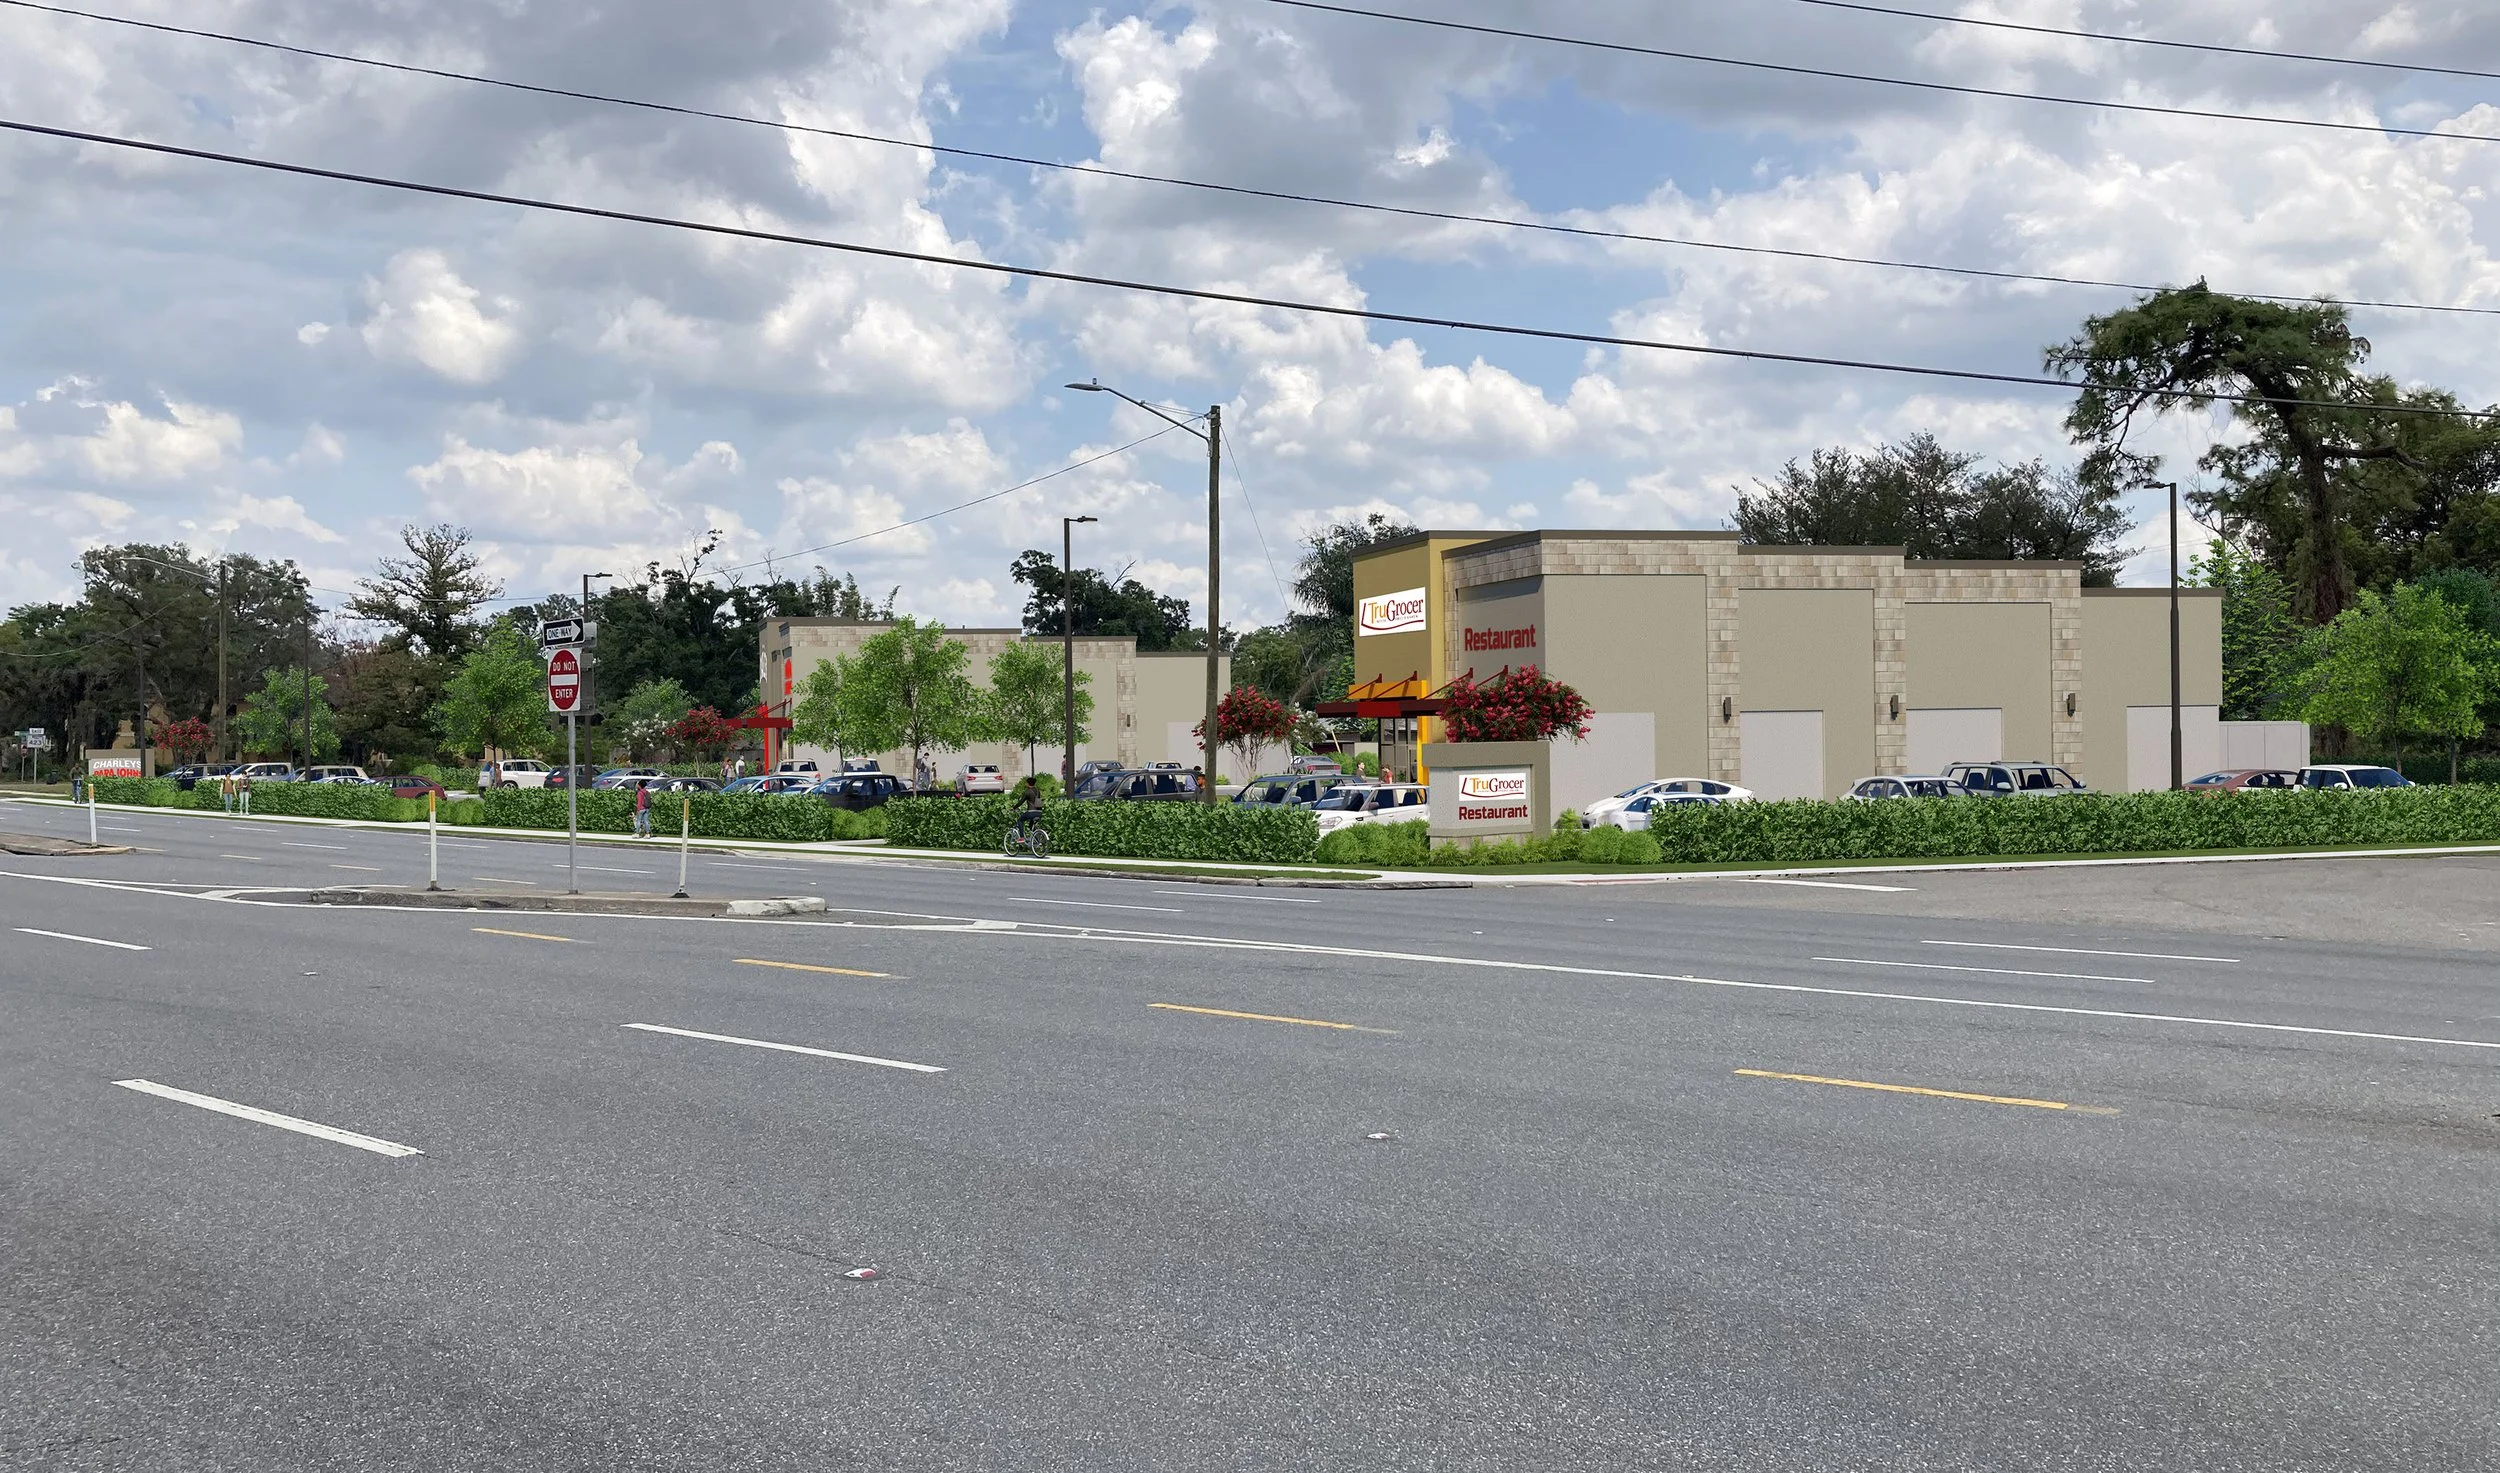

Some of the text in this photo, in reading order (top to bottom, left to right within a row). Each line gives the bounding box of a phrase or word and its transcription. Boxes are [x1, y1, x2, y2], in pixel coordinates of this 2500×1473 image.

[1367, 599, 1424, 624] TruGrocer
[548, 626, 572, 639] ONE WAY
[1464, 624, 1537, 651] Restaurant
[552, 661, 575, 671] DO NOT
[555, 688, 573, 699] ENTER
[93, 760, 141, 769] CHARLEYS
[1469, 777, 1525, 793] TruGrocer
[1459, 804, 1528, 820] Restaurant
